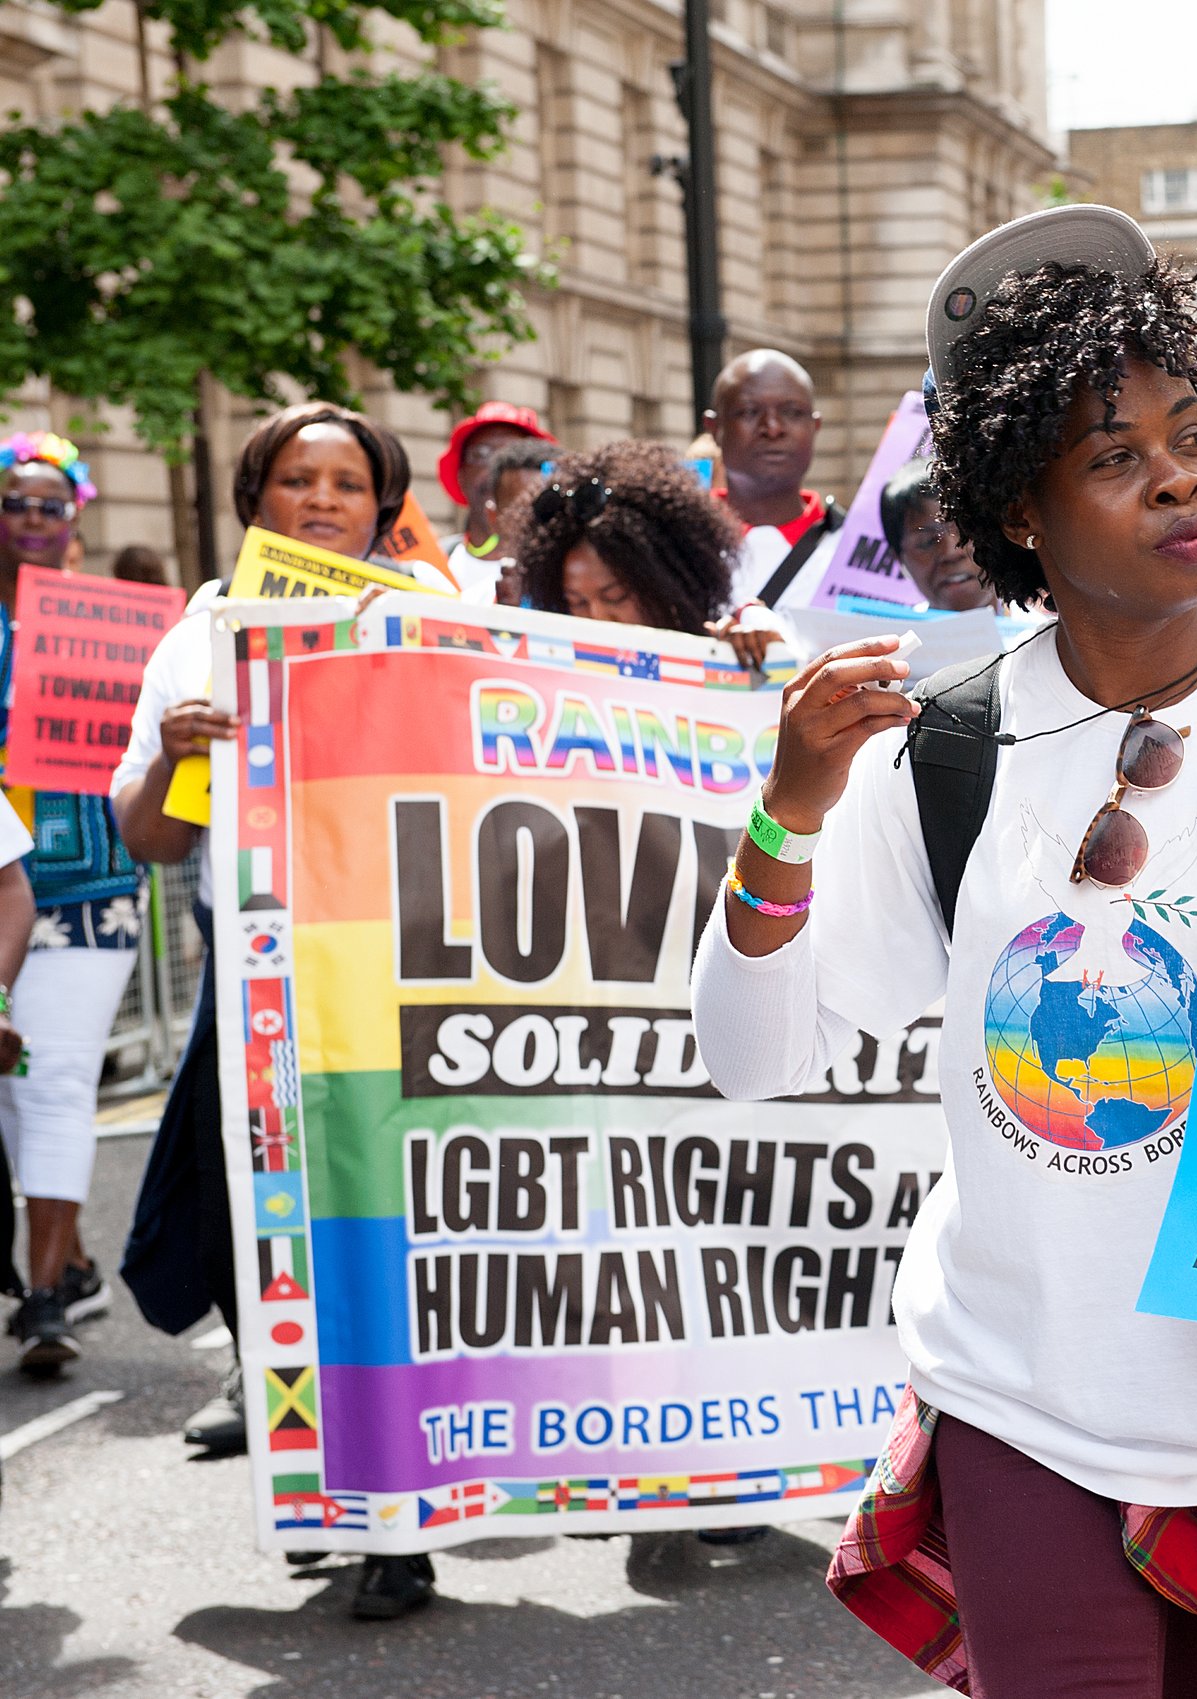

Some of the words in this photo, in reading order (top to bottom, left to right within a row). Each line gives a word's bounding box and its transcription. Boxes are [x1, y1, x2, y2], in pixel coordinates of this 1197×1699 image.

[39, 596, 164, 630] CHANGING
[35, 717, 76, 742] THE
[428, 1013, 943, 1097] SOLIDRIT
[972, 1066, 1041, 1161] RAINBOWS
[1046, 1151, 1133, 1176] ACROSS
[411, 1137, 589, 1233] LGBT
[608, 1135, 876, 1230] RIGHTS
[415, 1248, 685, 1354] HUMAN
[425, 1408, 508, 1458] THE
[538, 1395, 779, 1450] BORDERS
